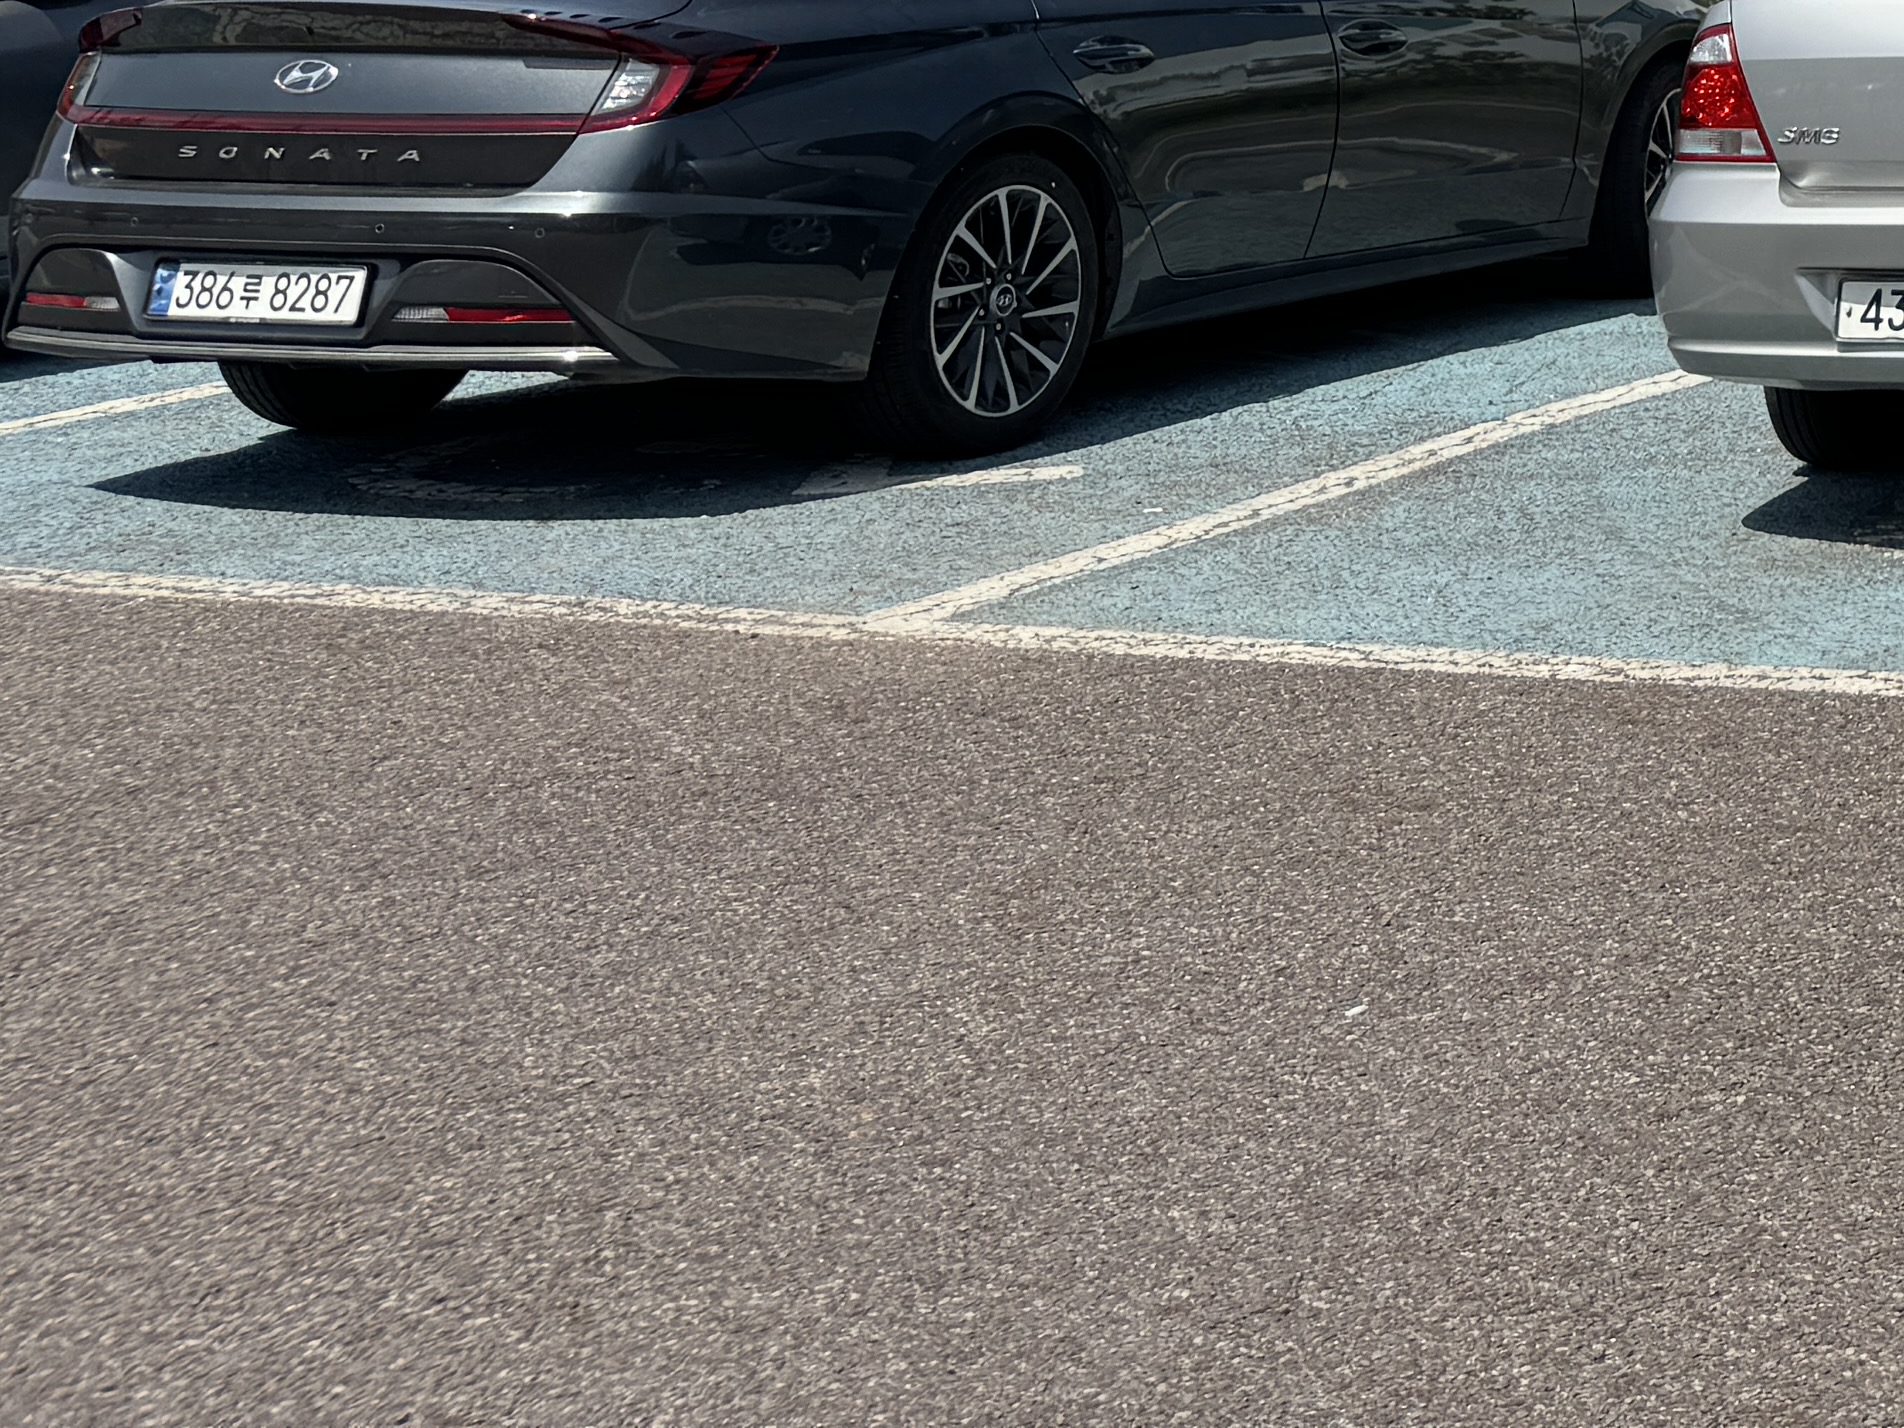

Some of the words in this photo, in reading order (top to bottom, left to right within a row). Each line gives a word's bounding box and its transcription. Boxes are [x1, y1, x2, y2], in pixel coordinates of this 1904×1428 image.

[178, 145, 421, 162] SONATA
[175, 270, 263, 310] 386루
[269, 271, 355, 314] 8287
